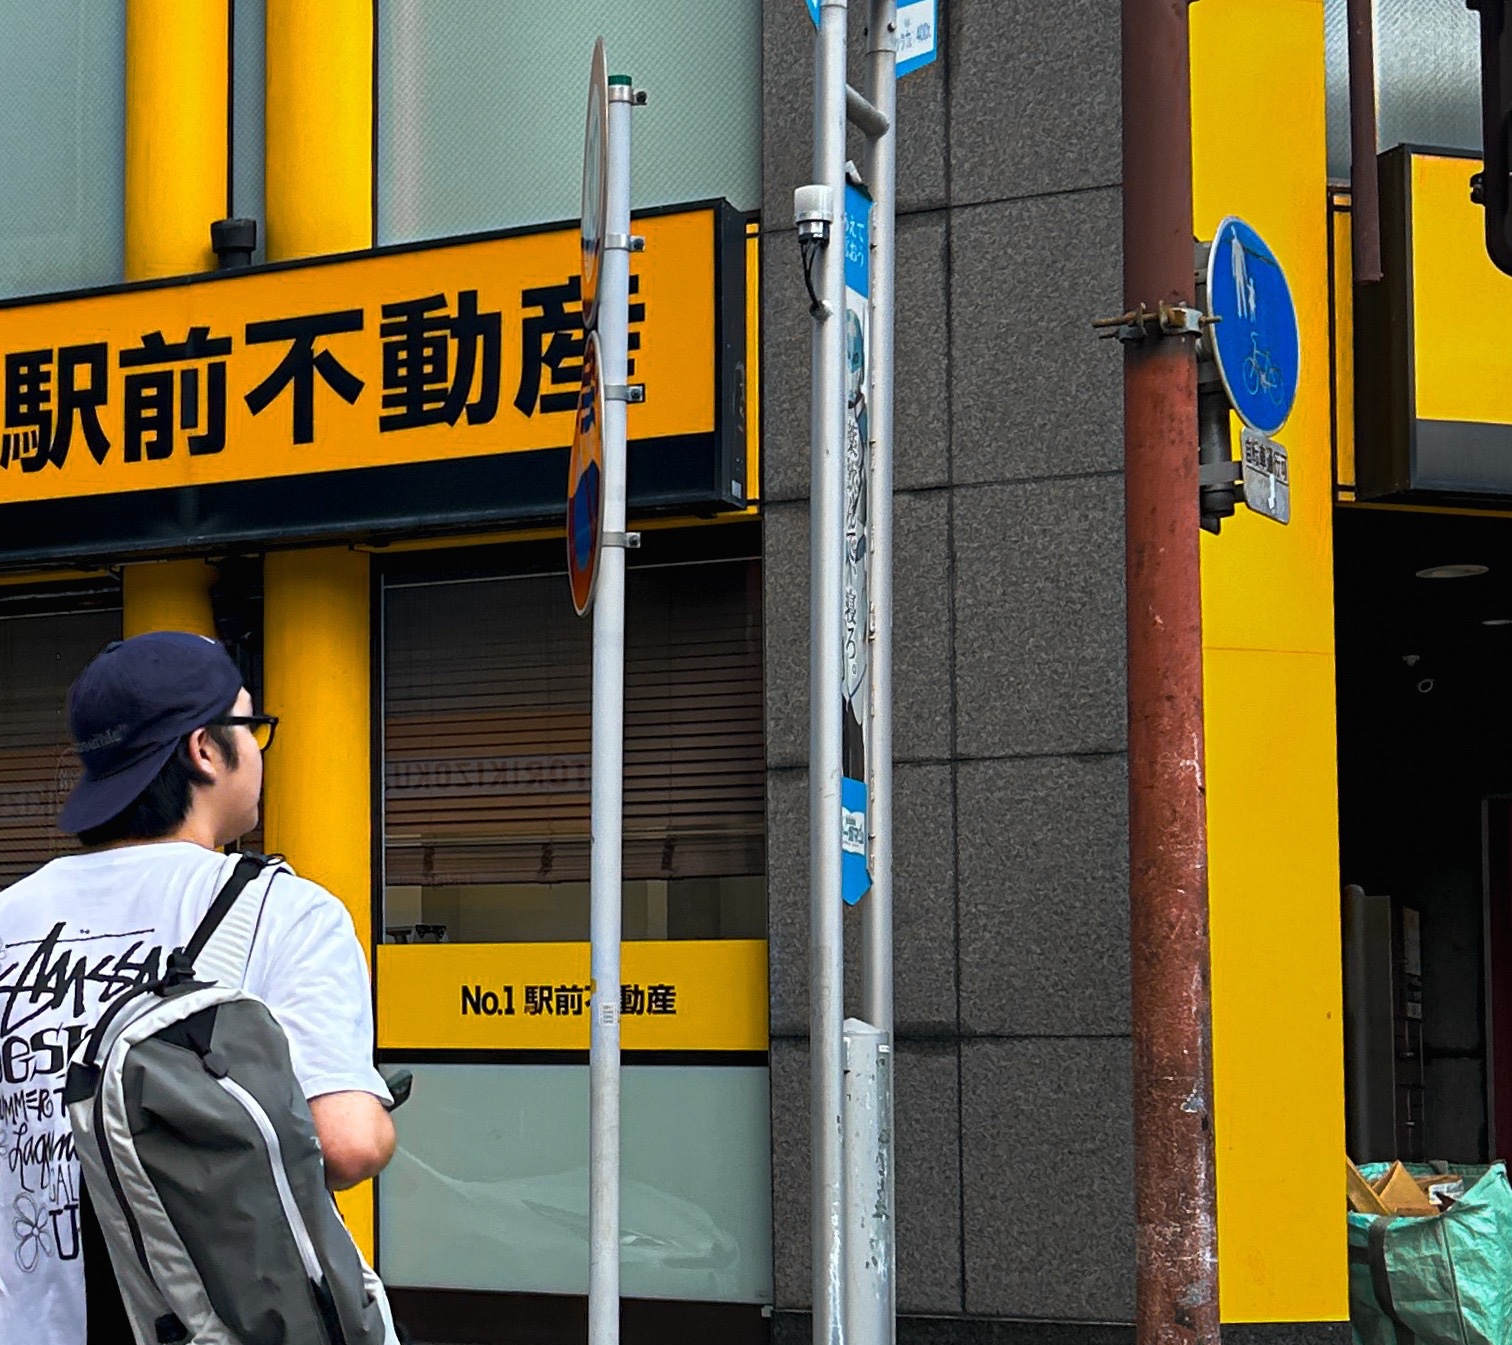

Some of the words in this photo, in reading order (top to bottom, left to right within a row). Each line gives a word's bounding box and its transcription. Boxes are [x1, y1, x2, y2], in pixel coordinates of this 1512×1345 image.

[460, 984, 516, 1017] No.1
[523, 983, 677, 1016] 駅前動産
